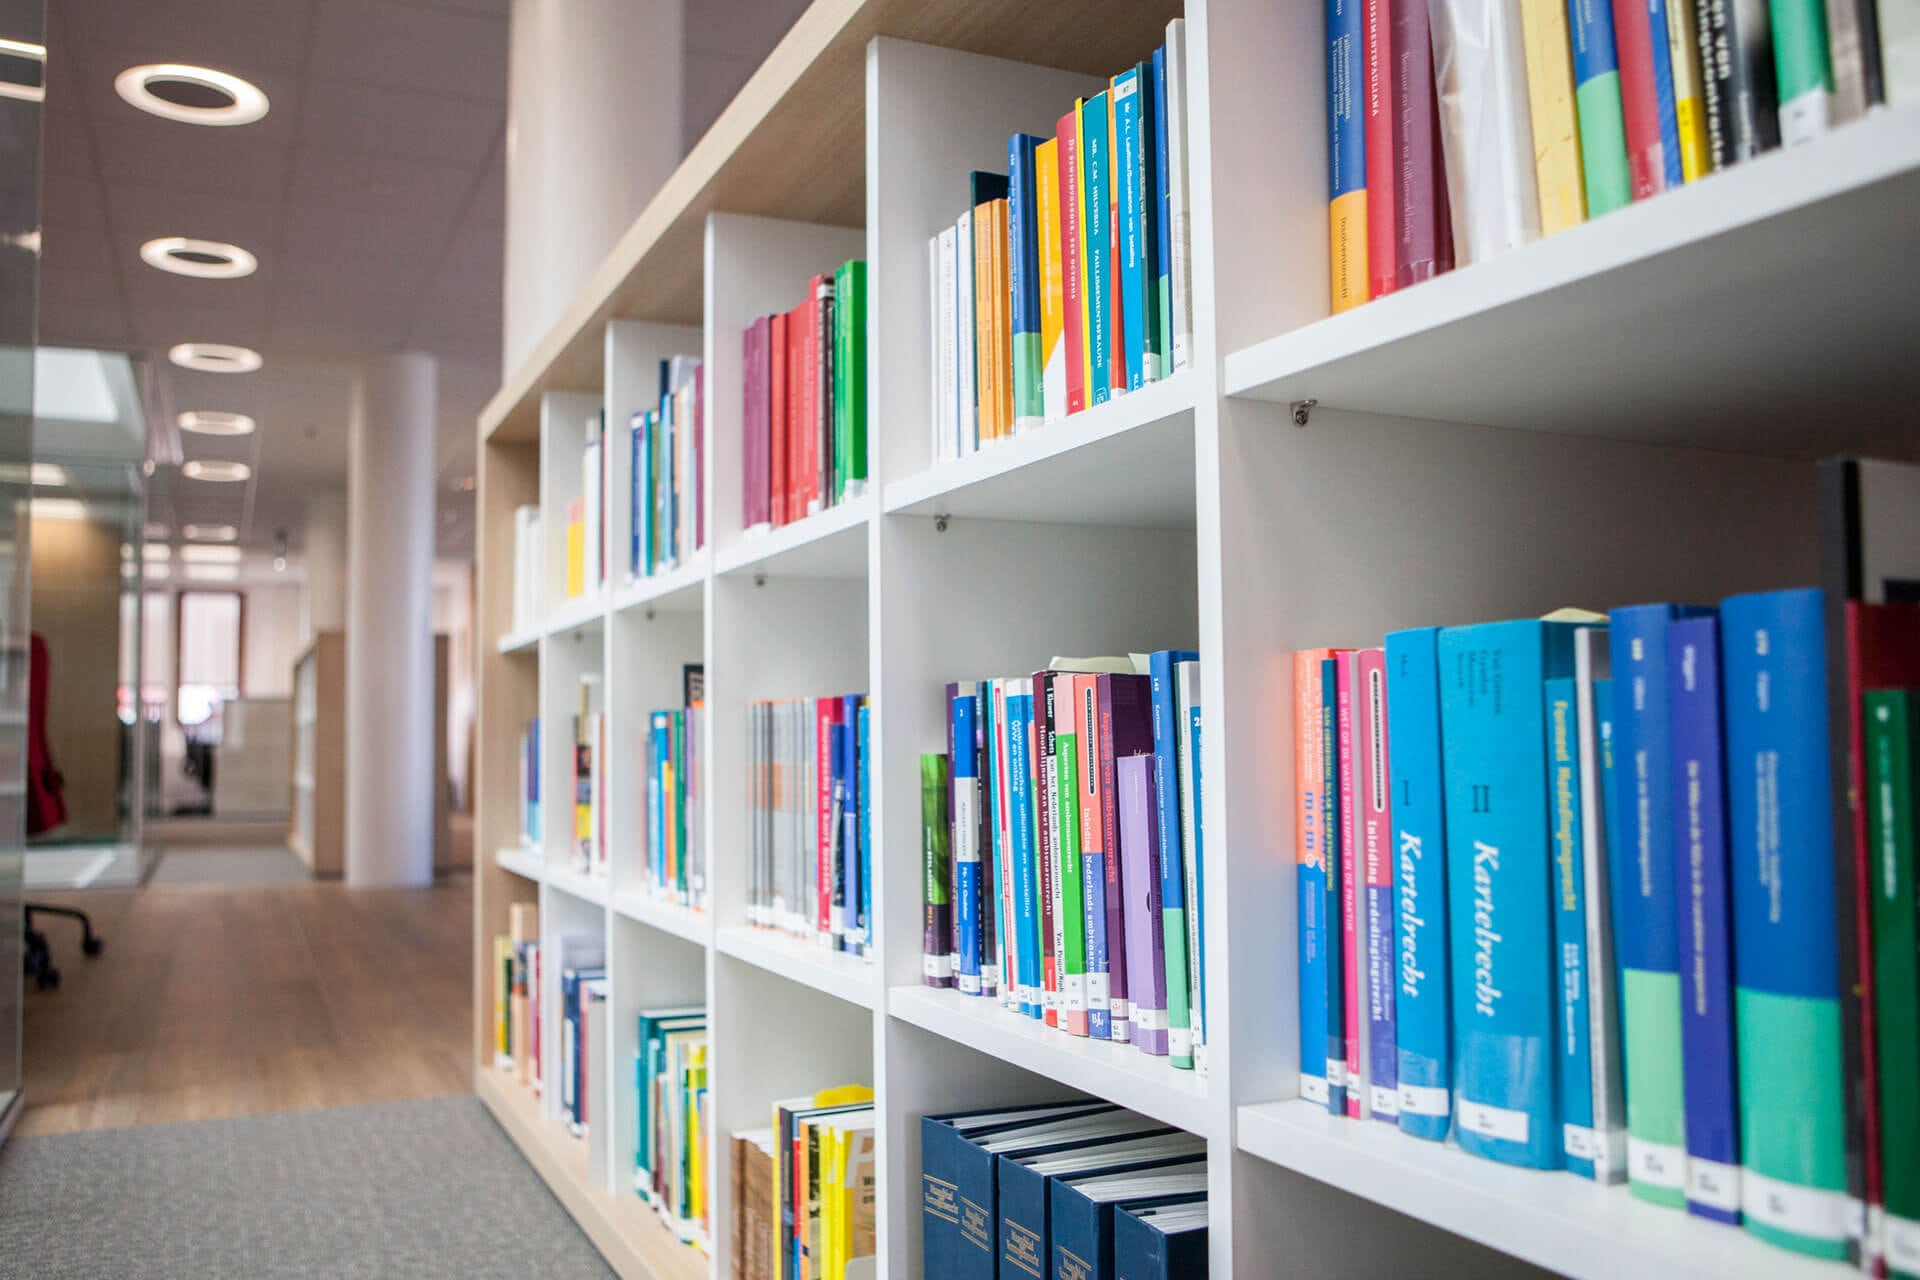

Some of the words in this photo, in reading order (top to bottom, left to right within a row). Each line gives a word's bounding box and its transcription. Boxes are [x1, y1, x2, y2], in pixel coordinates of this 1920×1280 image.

[1039, 725, 1049, 786] Hoofdlijnen
[1104, 764, 1112, 785] van
[1043, 811, 1051, 826] het
[1044, 830, 1053, 916] ambtenarenrecht
[1085, 855, 1095, 911] Nederlands
[1367, 820, 1379, 884] Inleiding
[1400, 829, 1426, 998] Kartelrecht
[1473, 839, 1504, 1017] Kartelrecht
[1368, 887, 1382, 1021] mededingingsrecht
